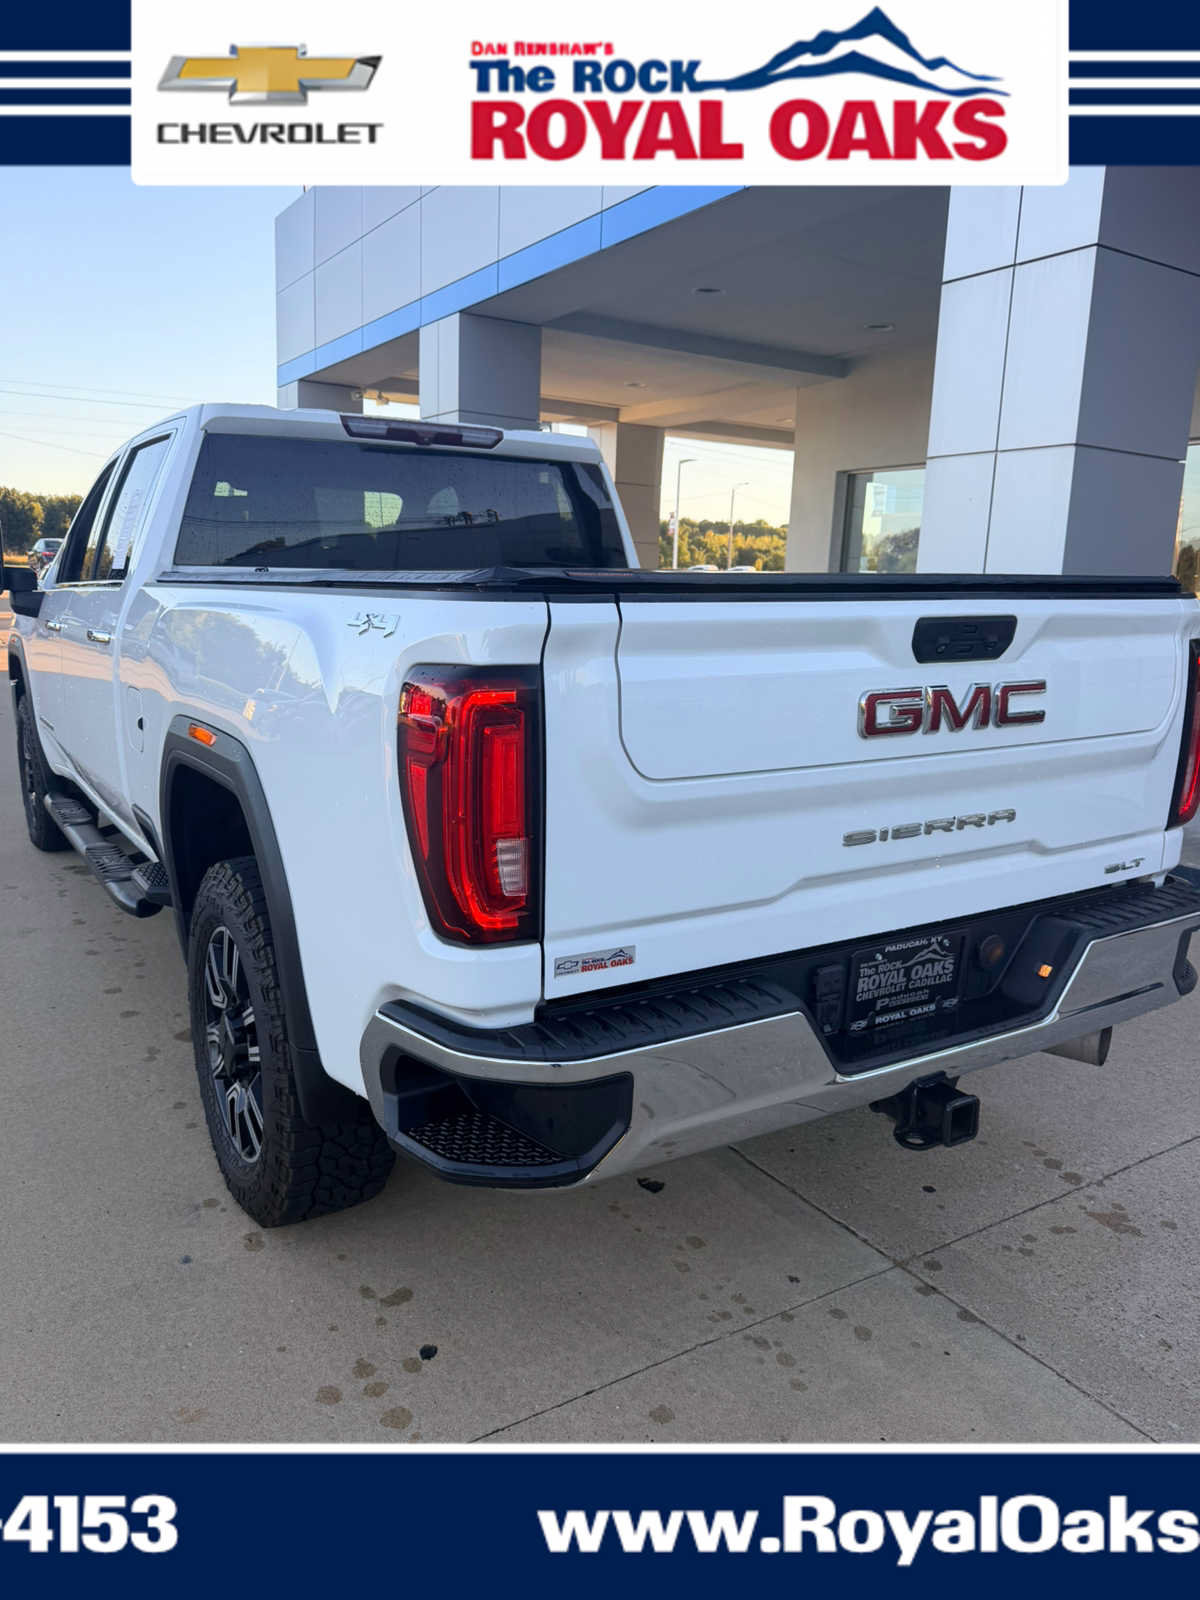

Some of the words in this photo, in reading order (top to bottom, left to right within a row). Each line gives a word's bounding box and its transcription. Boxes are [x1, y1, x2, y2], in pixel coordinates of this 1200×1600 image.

[858, 680, 1047, 738] GMC
[843, 808, 1017, 847] SIERRA
[1104, 857, 1145, 874] SLT
[581, 962, 608, 973] ROYAL
[610, 956, 633, 968] OAKS
[857, 970, 906, 993] ROYAL
[911, 959, 955, 980] OAKS
[878, 959, 903, 973] ROCK
[855, 983, 906, 1002] CHEVROLET
[908, 974, 953, 990] CADILLAC
[875, 1012, 907, 1025] ROYAL
[909, 1003, 936, 1015] OAKS
